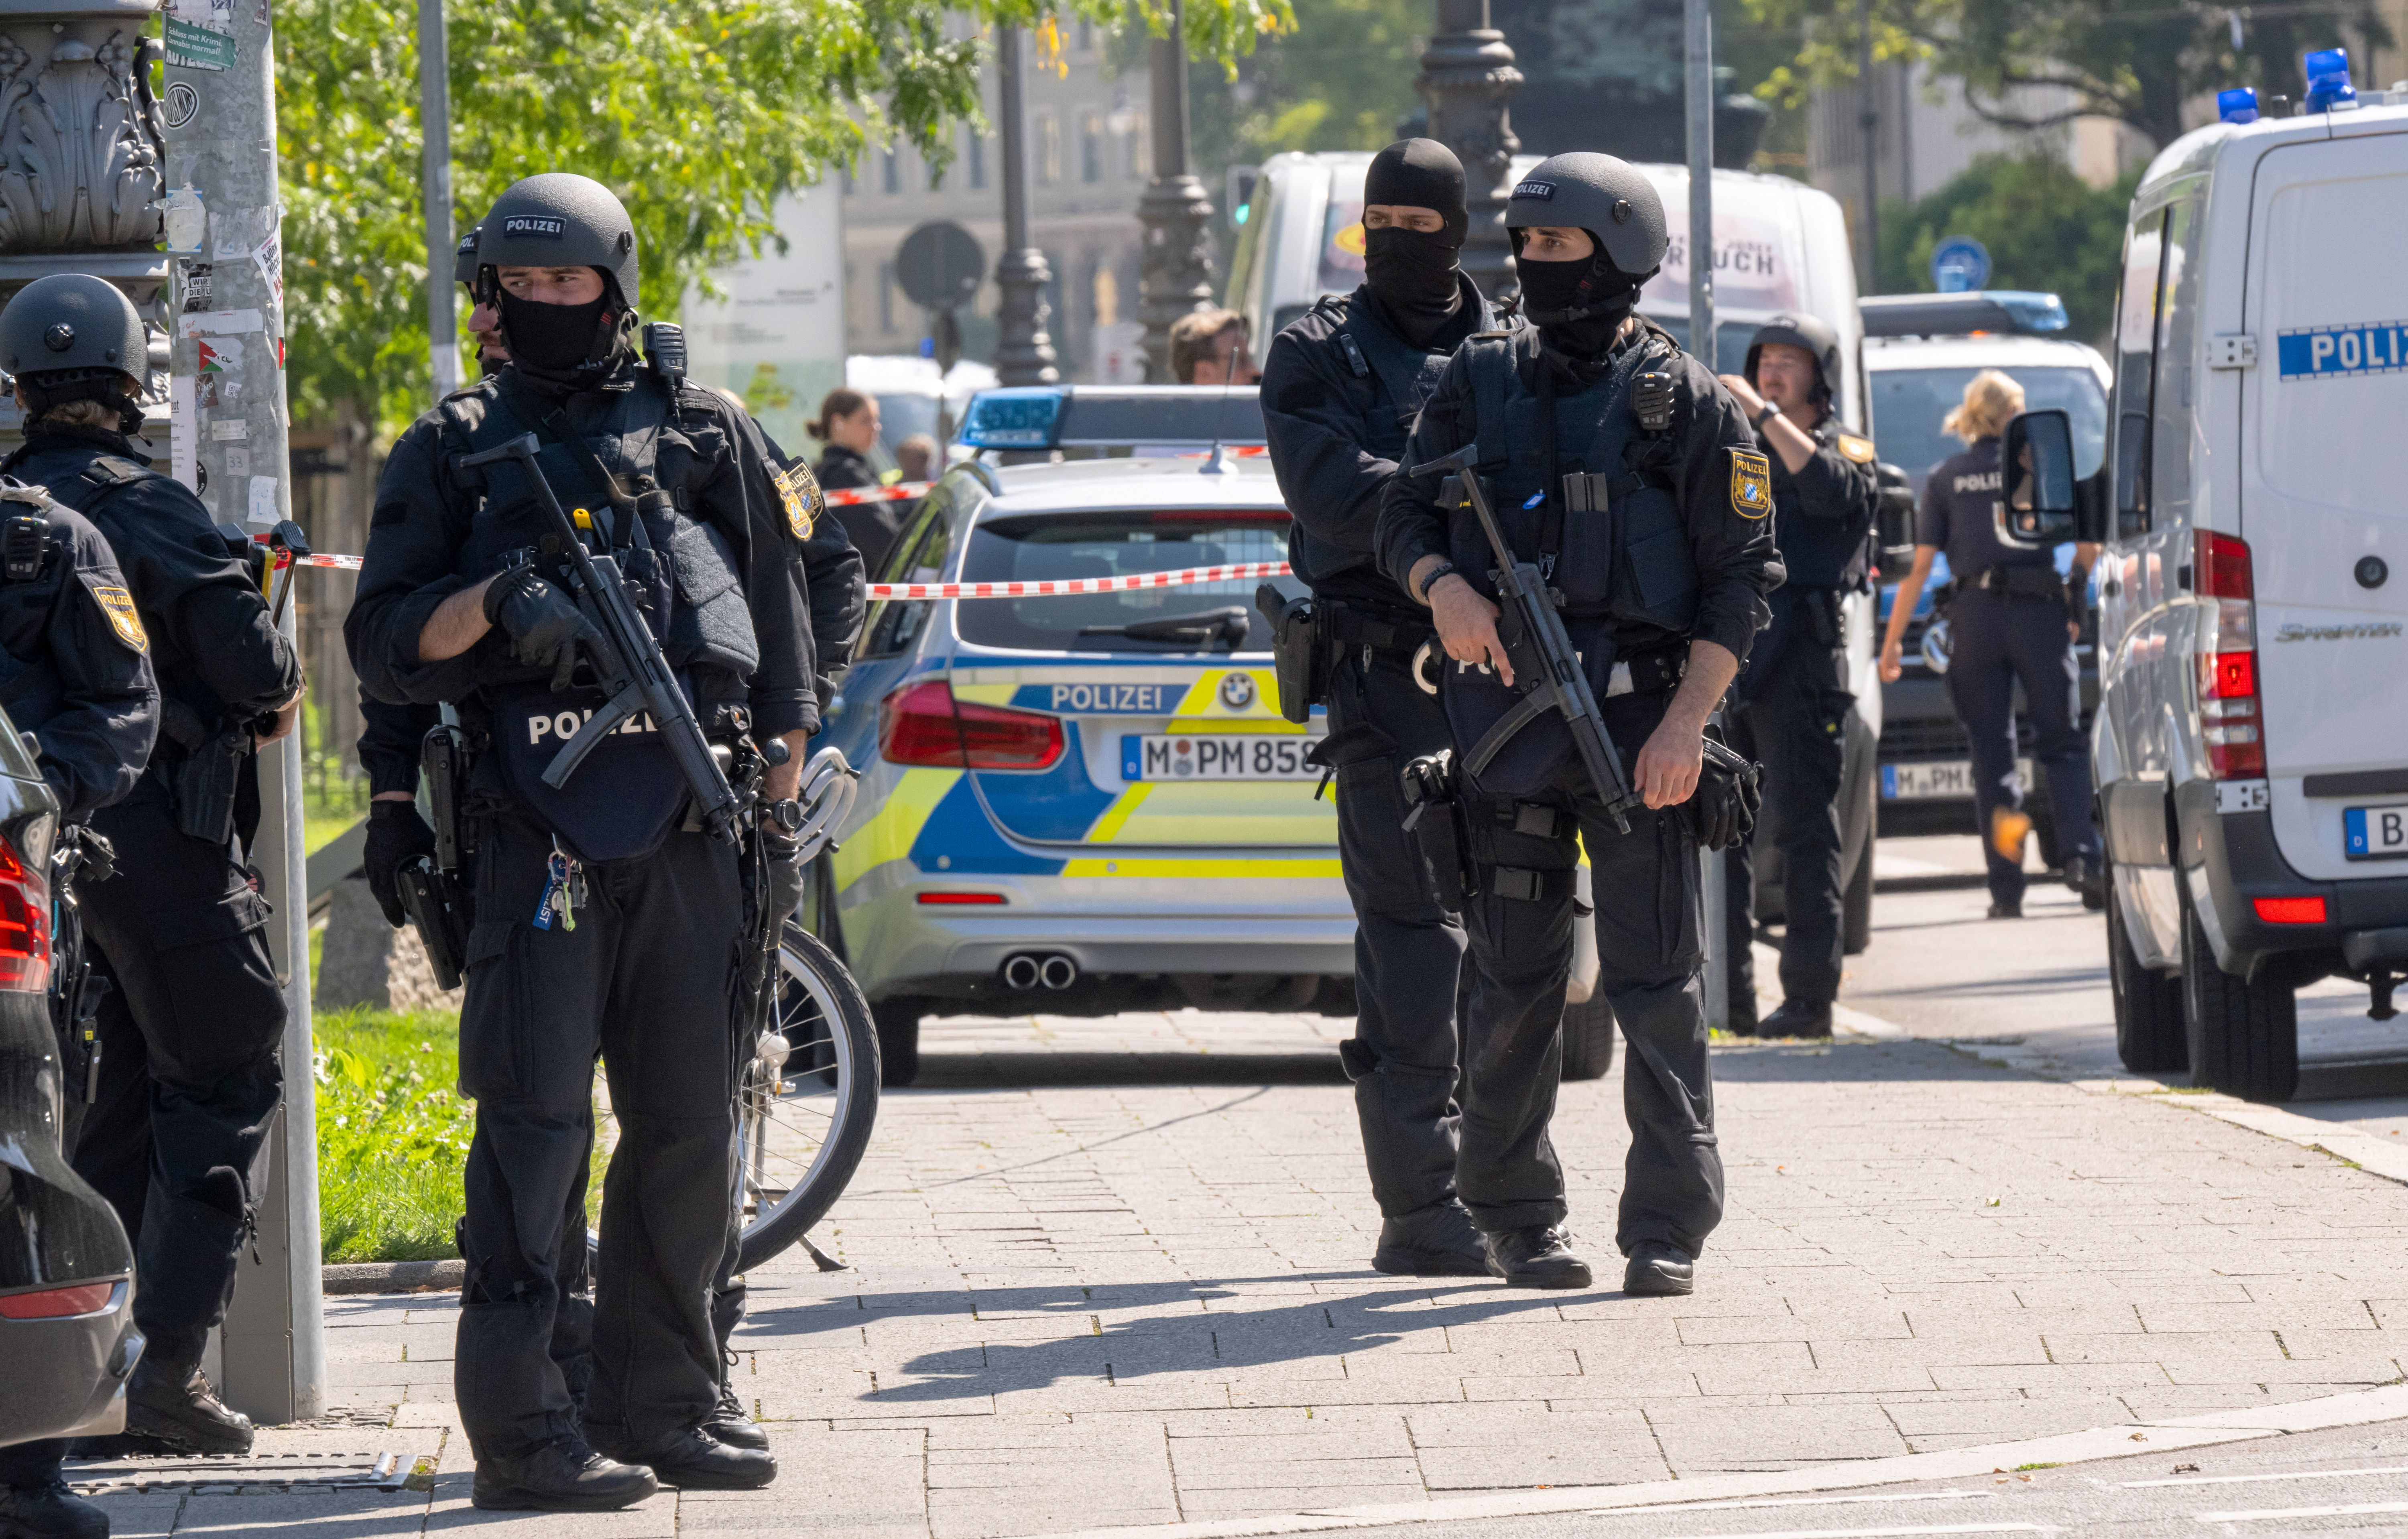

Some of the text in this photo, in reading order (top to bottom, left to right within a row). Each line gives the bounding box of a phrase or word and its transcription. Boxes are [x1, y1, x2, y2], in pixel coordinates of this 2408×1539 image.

[167, 36, 220, 55] Cannabis normal!
[169, 26, 187, 39] Schluss
[201, 35, 222, 47] Krimi.
[1514, 184, 1550, 195] POLIZEI
[506, 220, 561, 233] POLIZEI
[262, 242, 278, 264] BJÖRN
[1668, 246, 1773, 274] RUCH
[267, 254, 280, 276] HÖCKE
[2311, 329, 2408, 371] POLI
[1737, 459, 1766, 475] POLIZEI
[790, 470, 810, 490] OLIZEI
[1052, 685, 1161, 710] POLIZEI
[1147, 740, 1169, 774] M
[1197, 740, 1243, 774] PM
[2382, 813, 2404, 846] B
